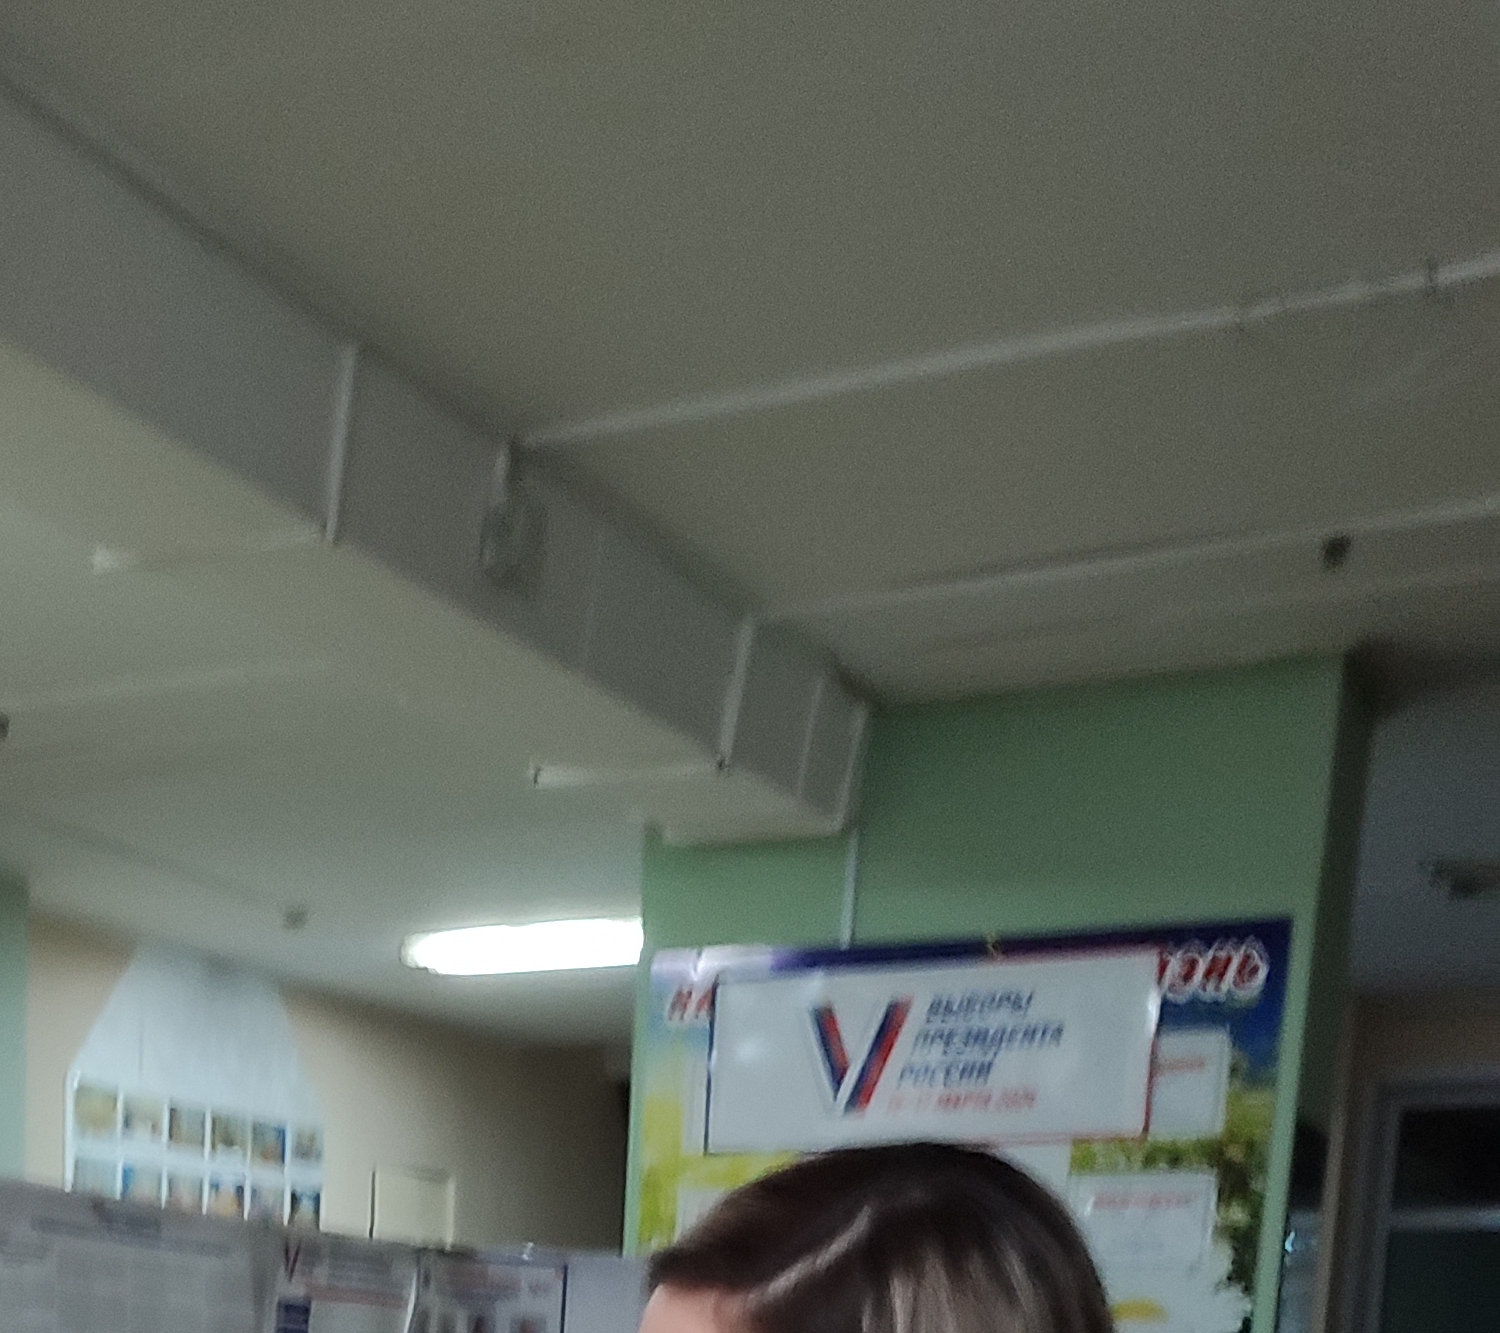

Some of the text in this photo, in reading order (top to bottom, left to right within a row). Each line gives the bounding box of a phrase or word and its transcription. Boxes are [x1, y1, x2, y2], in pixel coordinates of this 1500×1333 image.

[925, 989, 1034, 1024] ВЫБОРЫ
[911, 1020, 1065, 1057] ПРЕЗИДЕНТА
[897, 1058, 997, 1090] РОССИИ
